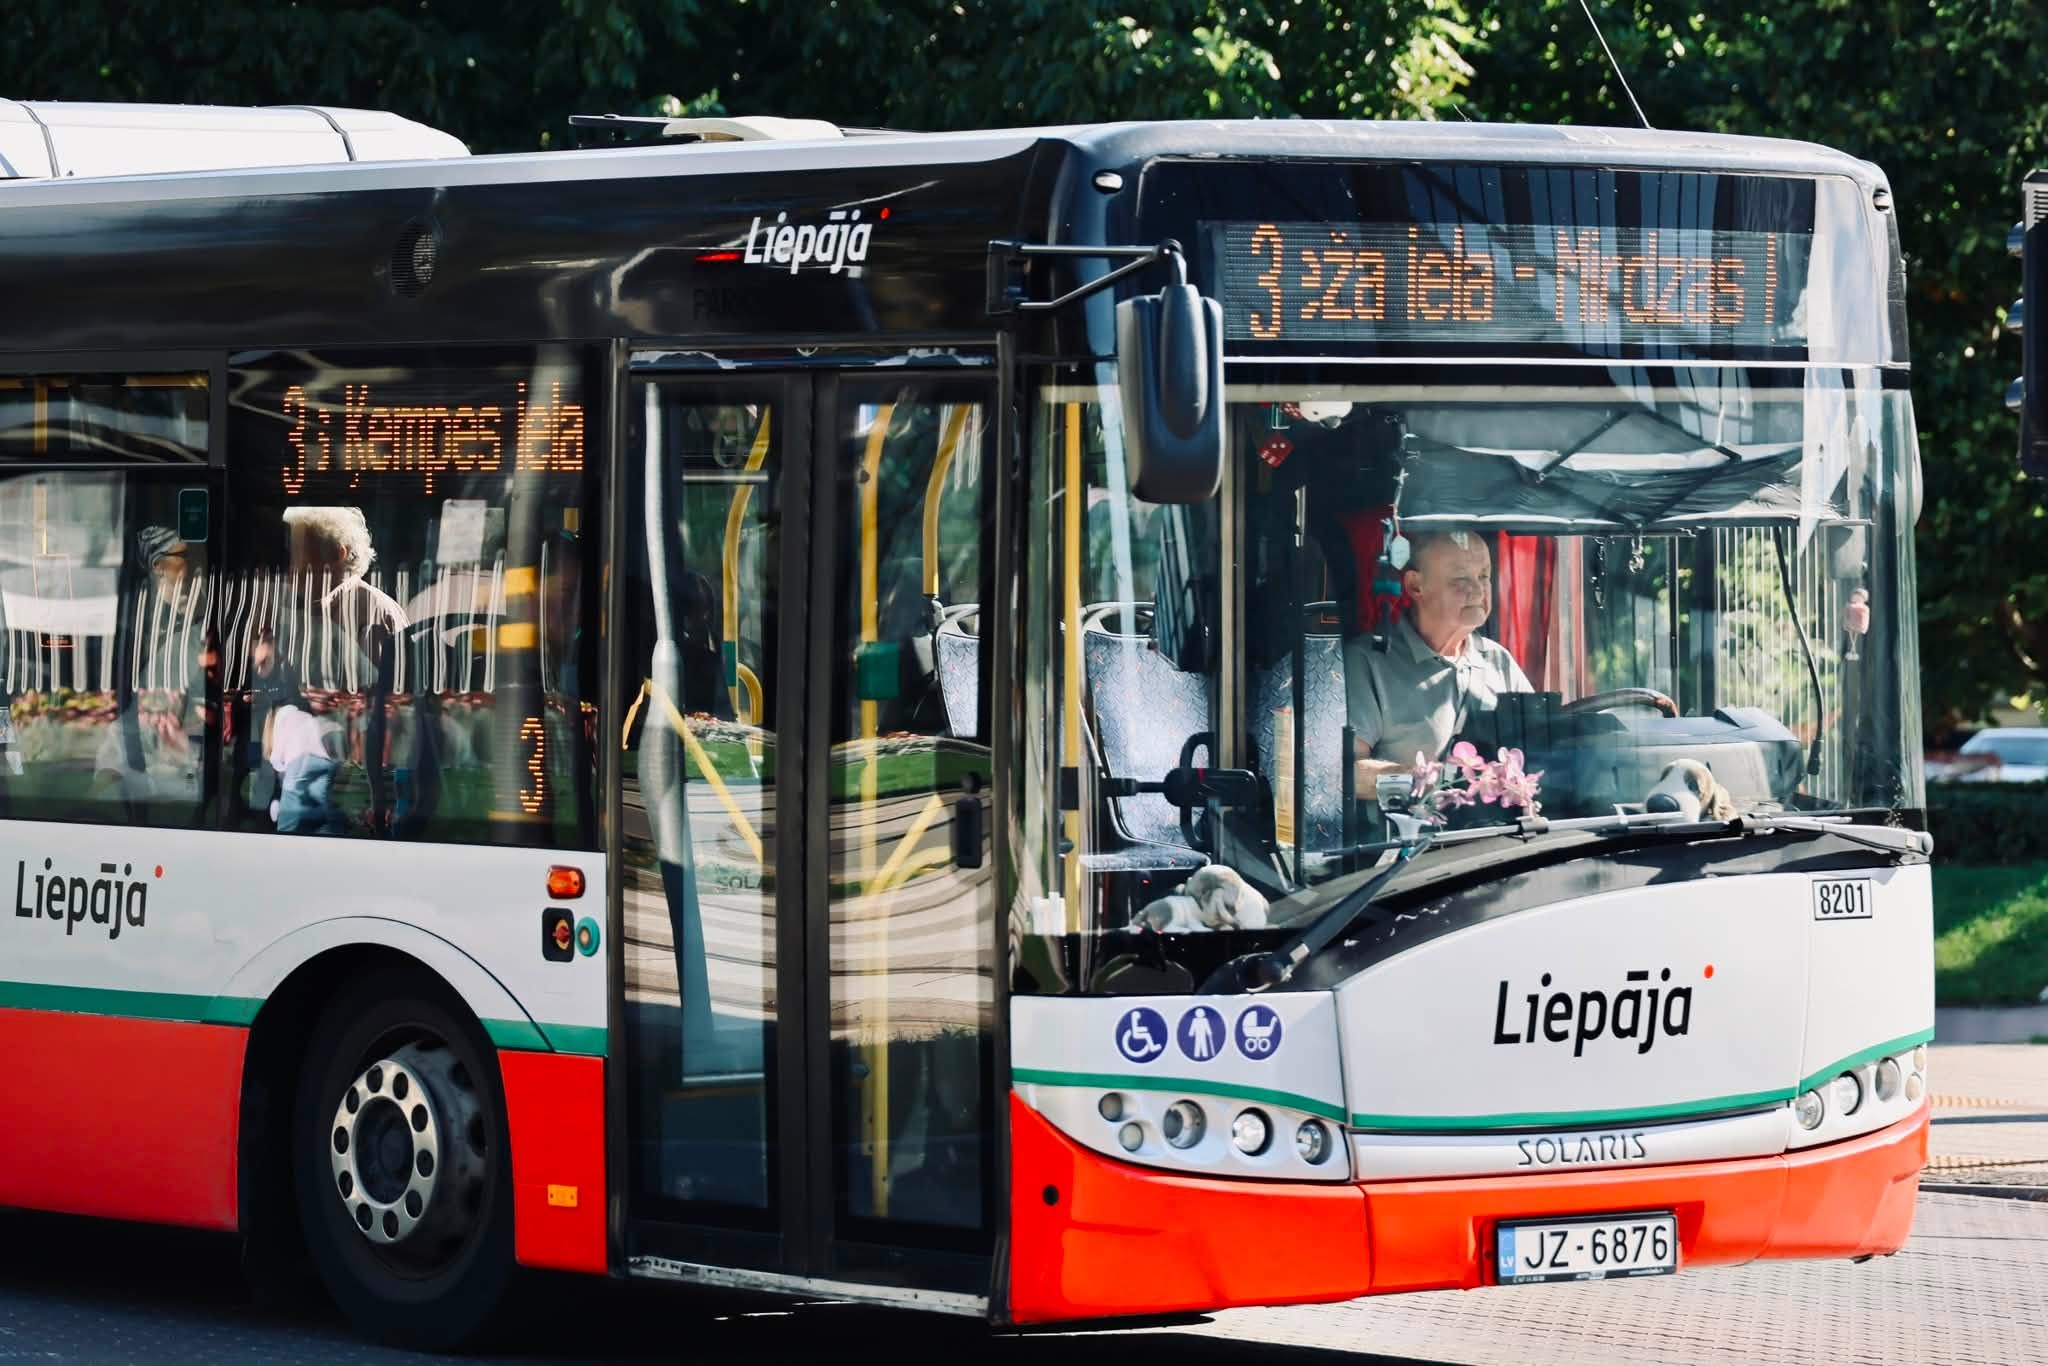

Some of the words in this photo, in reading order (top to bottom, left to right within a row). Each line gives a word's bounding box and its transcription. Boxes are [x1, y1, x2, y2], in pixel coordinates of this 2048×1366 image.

[744, 209, 873, 275] Liepāja
[1250, 223, 1283, 339] 3
[1407, 225, 1494, 322] iela
[1555, 229, 1746, 326] Mirdzas
[282, 385, 305, 495] 3
[517, 381, 584, 471] iela
[519, 717, 544, 813] 3
[15, 857, 148, 940] Liepāja
[1820, 883, 1864, 914] 8201
[1493, 967, 1693, 1058] Liepāja
[1517, 1133, 1646, 1165] SOLARIS
[1525, 1225, 1668, 1269] JZ-6876
